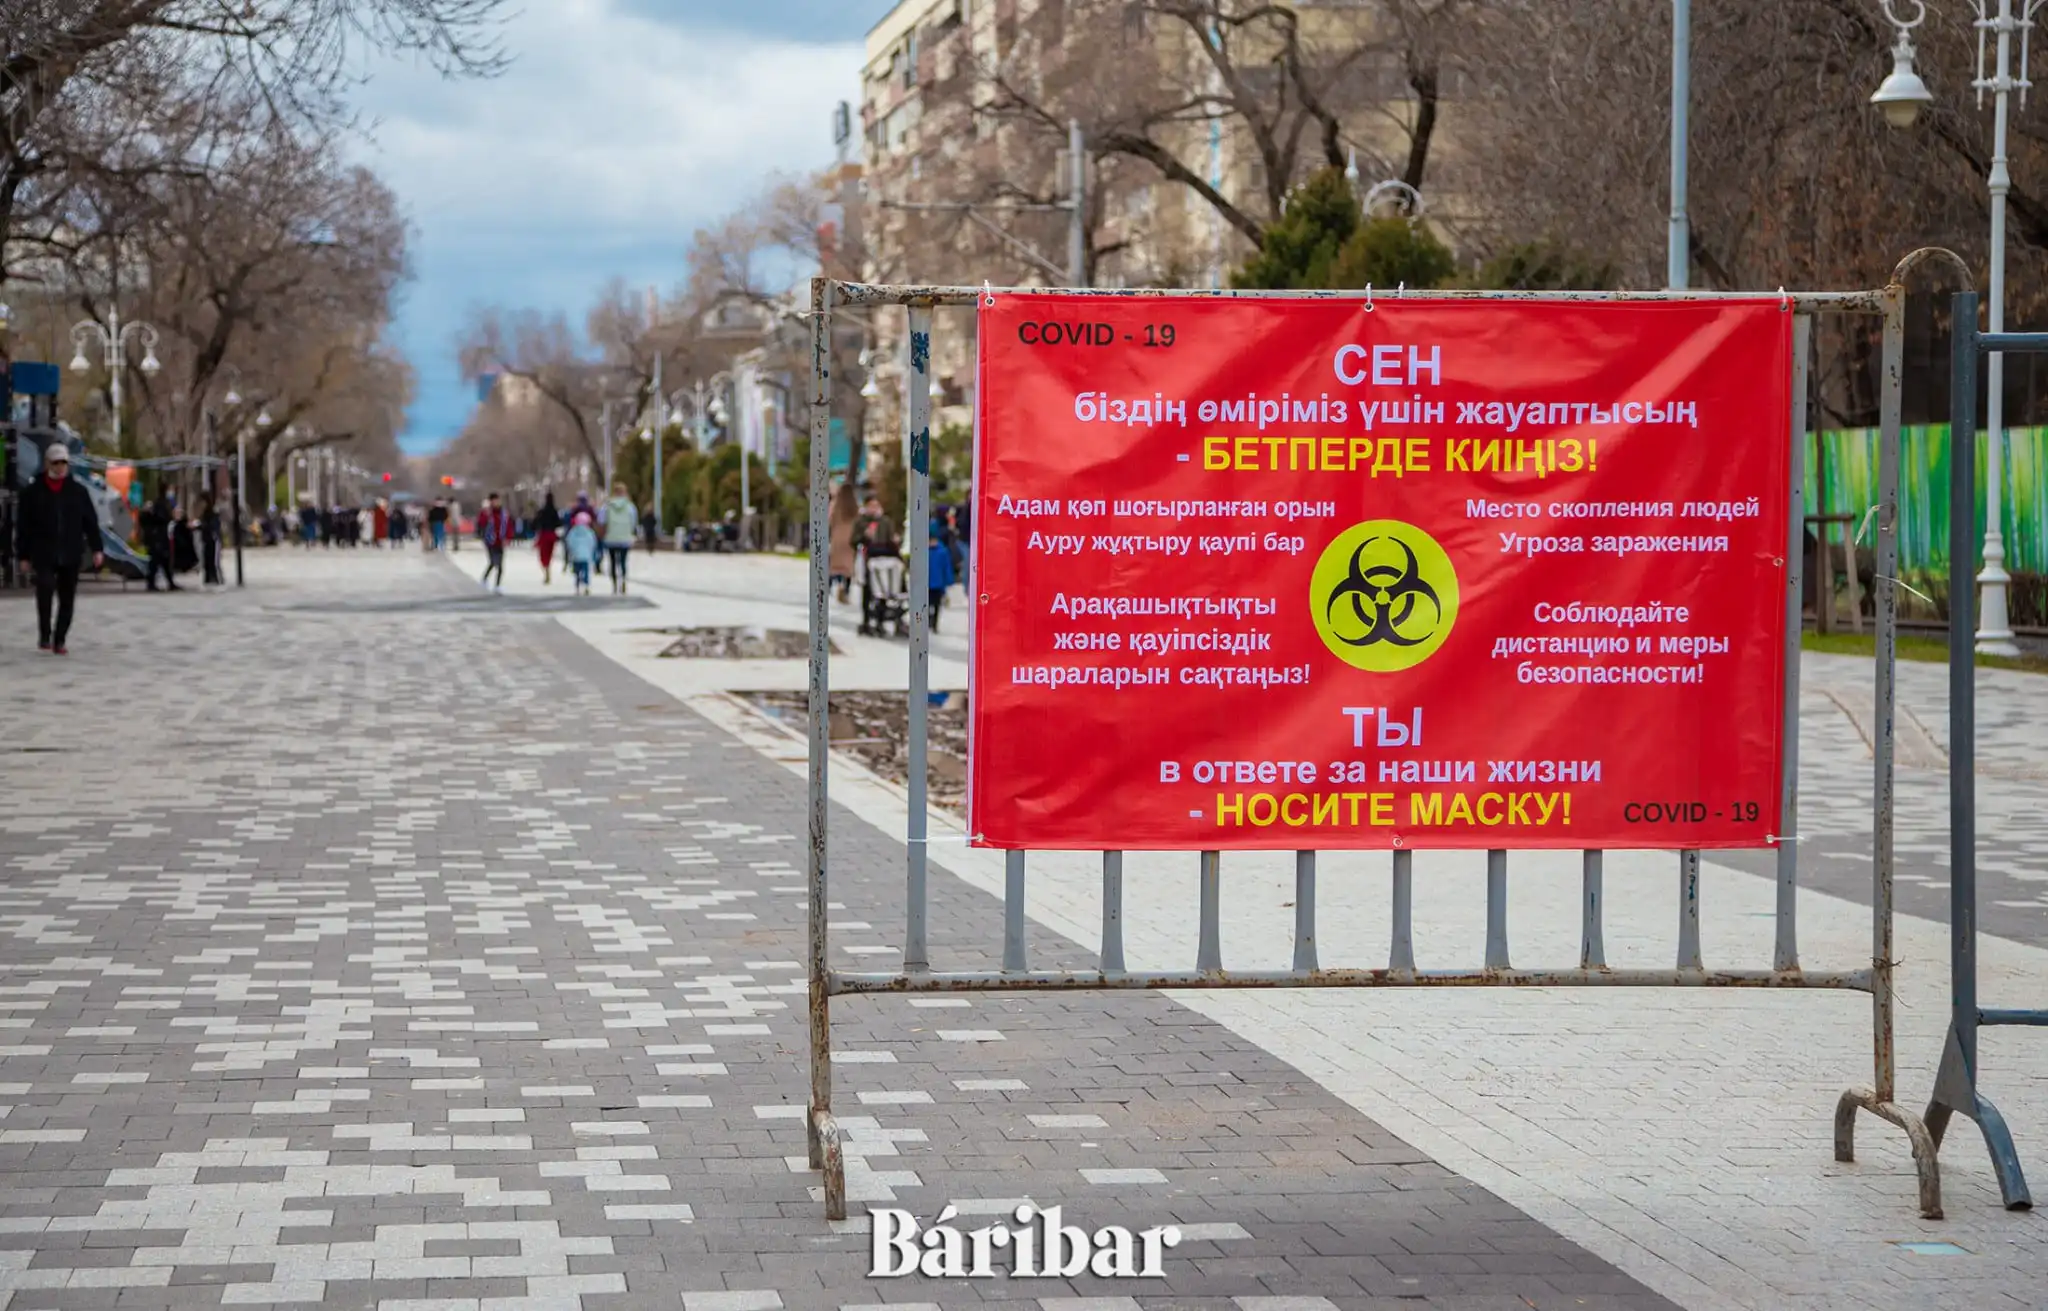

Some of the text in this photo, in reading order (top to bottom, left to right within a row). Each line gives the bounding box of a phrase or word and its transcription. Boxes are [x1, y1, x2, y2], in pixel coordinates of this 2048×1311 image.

[1019, 322, 1113, 345] COVID
[1143, 324, 1176, 347] 19
[1334, 344, 1440, 385] СЕН
[1075, 392, 1697, 431] біздің өміріміз үшін жауаптысың
[1204, 437, 1429, 477] БЕТПЕРДЕ
[1447, 439, 1596, 478] КИІҢІЗ!
[997, 494, 1059, 518] Адам
[1114, 501, 1266, 521] шоғырланған
[1274, 502, 1334, 521] орын
[1467, 497, 1758, 521] Место скопления людей
[1028, 532, 1304, 555] Ауру жұқтыру қаупі бар
[1500, 532, 1728, 557] Угроза заражения
[1051, 593, 1275, 620] Арақашықтықты
[1535, 601, 1688, 627] Соблюдайте
[1054, 628, 1270, 655] және қауіпсіздік
[1492, 637, 1728, 658] дистанцию и меры
[1013, 664, 1309, 689] шараларын сақтаңыз!
[1518, 661, 1702, 683] безопасности!
[1342, 707, 1421, 746] ТЫ
[1161, 761, 1600, 783] в ответе за наши жизни
[1217, 793, 1394, 825] НОСИТЕ
[1411, 793, 1570, 825] МАСКУ!
[1625, 802, 1706, 822] COVID
[1731, 801, 1759, 822] 19
